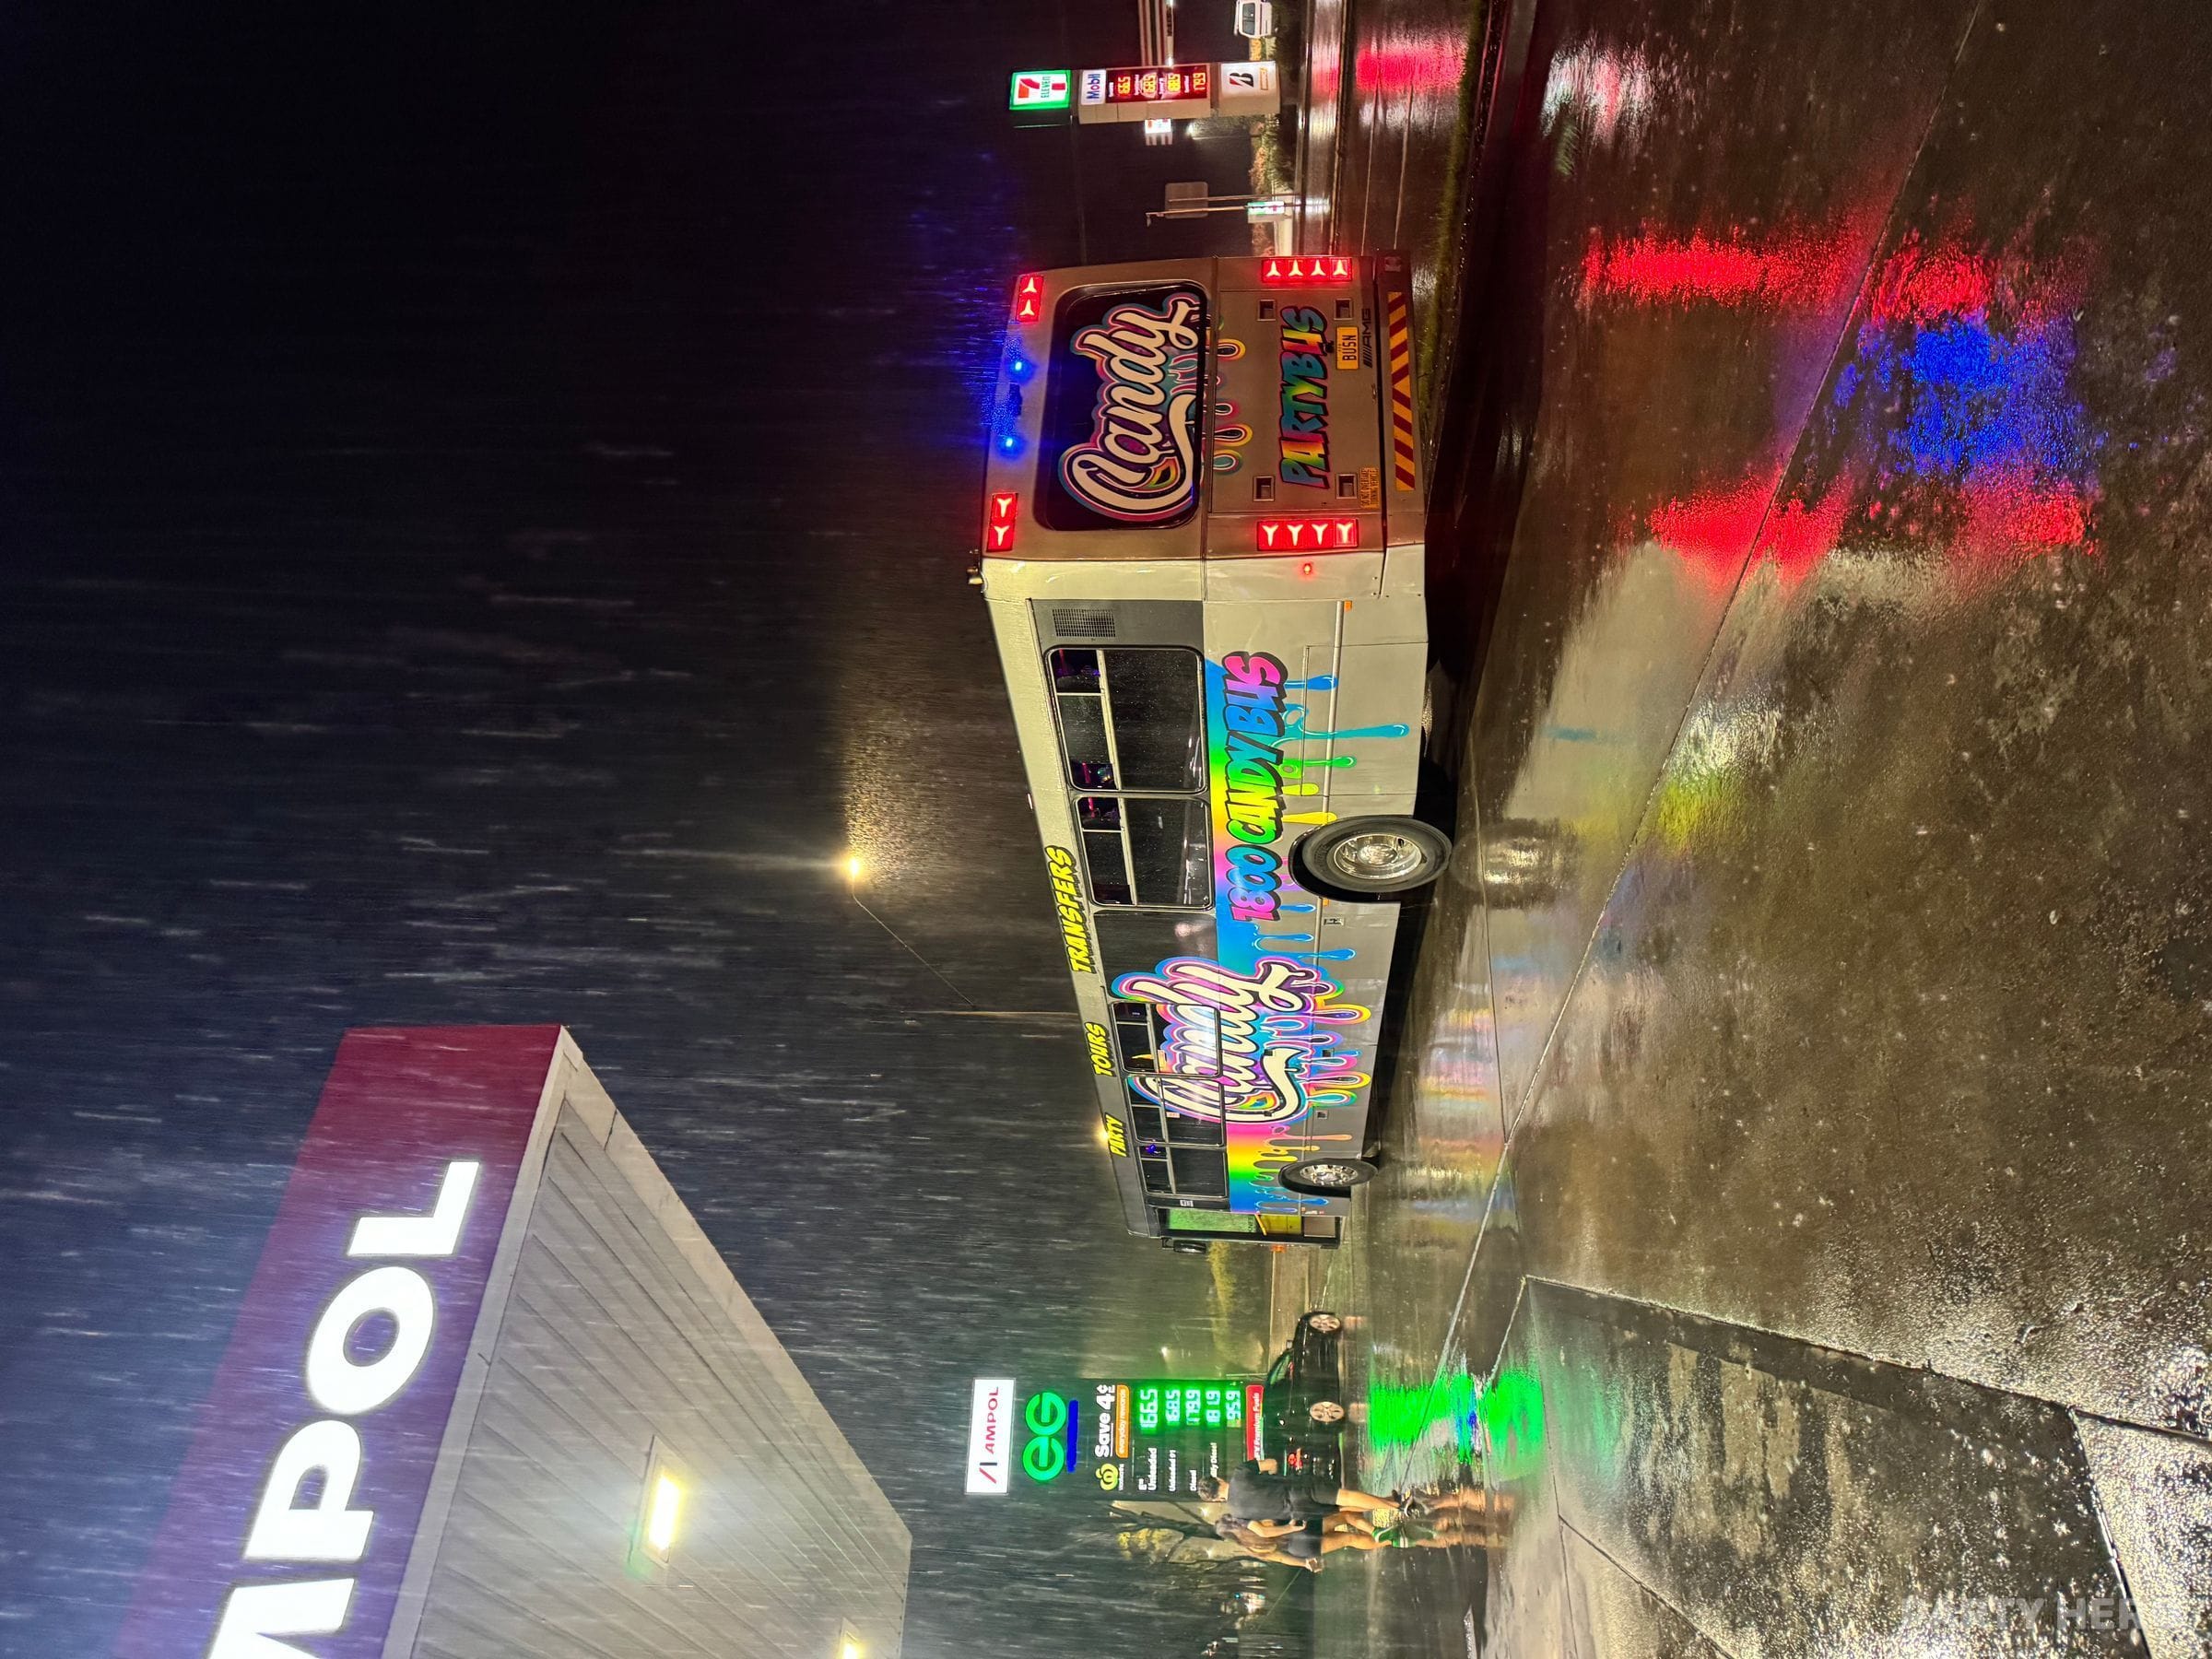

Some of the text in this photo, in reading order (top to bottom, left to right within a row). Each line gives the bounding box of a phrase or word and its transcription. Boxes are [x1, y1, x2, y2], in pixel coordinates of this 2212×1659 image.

[1086, 74, 1100, 100] Mobil
[1342, 335, 1357, 361] BUSN
[1070, 300, 1197, 512] Candy
[1227, 844, 1283, 922] 1800
[1044, 845, 1128, 1158] PARTY TOURS TRANSFERS
[1130, 960, 1305, 1122] Candy
[985, 1386, 998, 1454] AMPOL
[1095, 1413, 1111, 1457] Save
[1147, 1448, 1157, 1490] Unleaded
